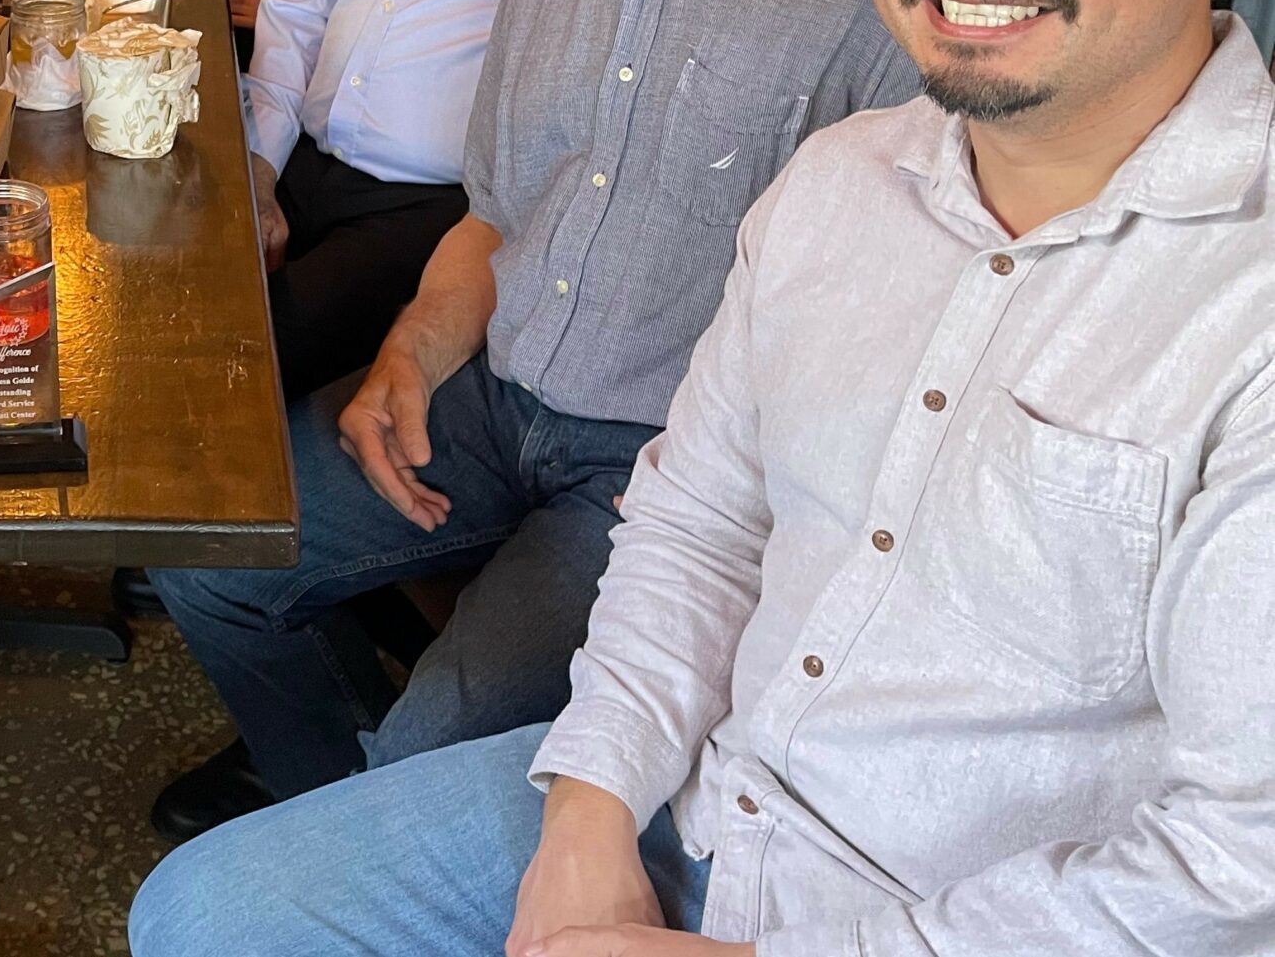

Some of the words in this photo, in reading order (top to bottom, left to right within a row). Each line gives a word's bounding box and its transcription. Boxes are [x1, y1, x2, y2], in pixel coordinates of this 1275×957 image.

[30, 365, 40, 373] of
[8, 399, 35, 407] Service
[10, 411, 36, 419] Center
